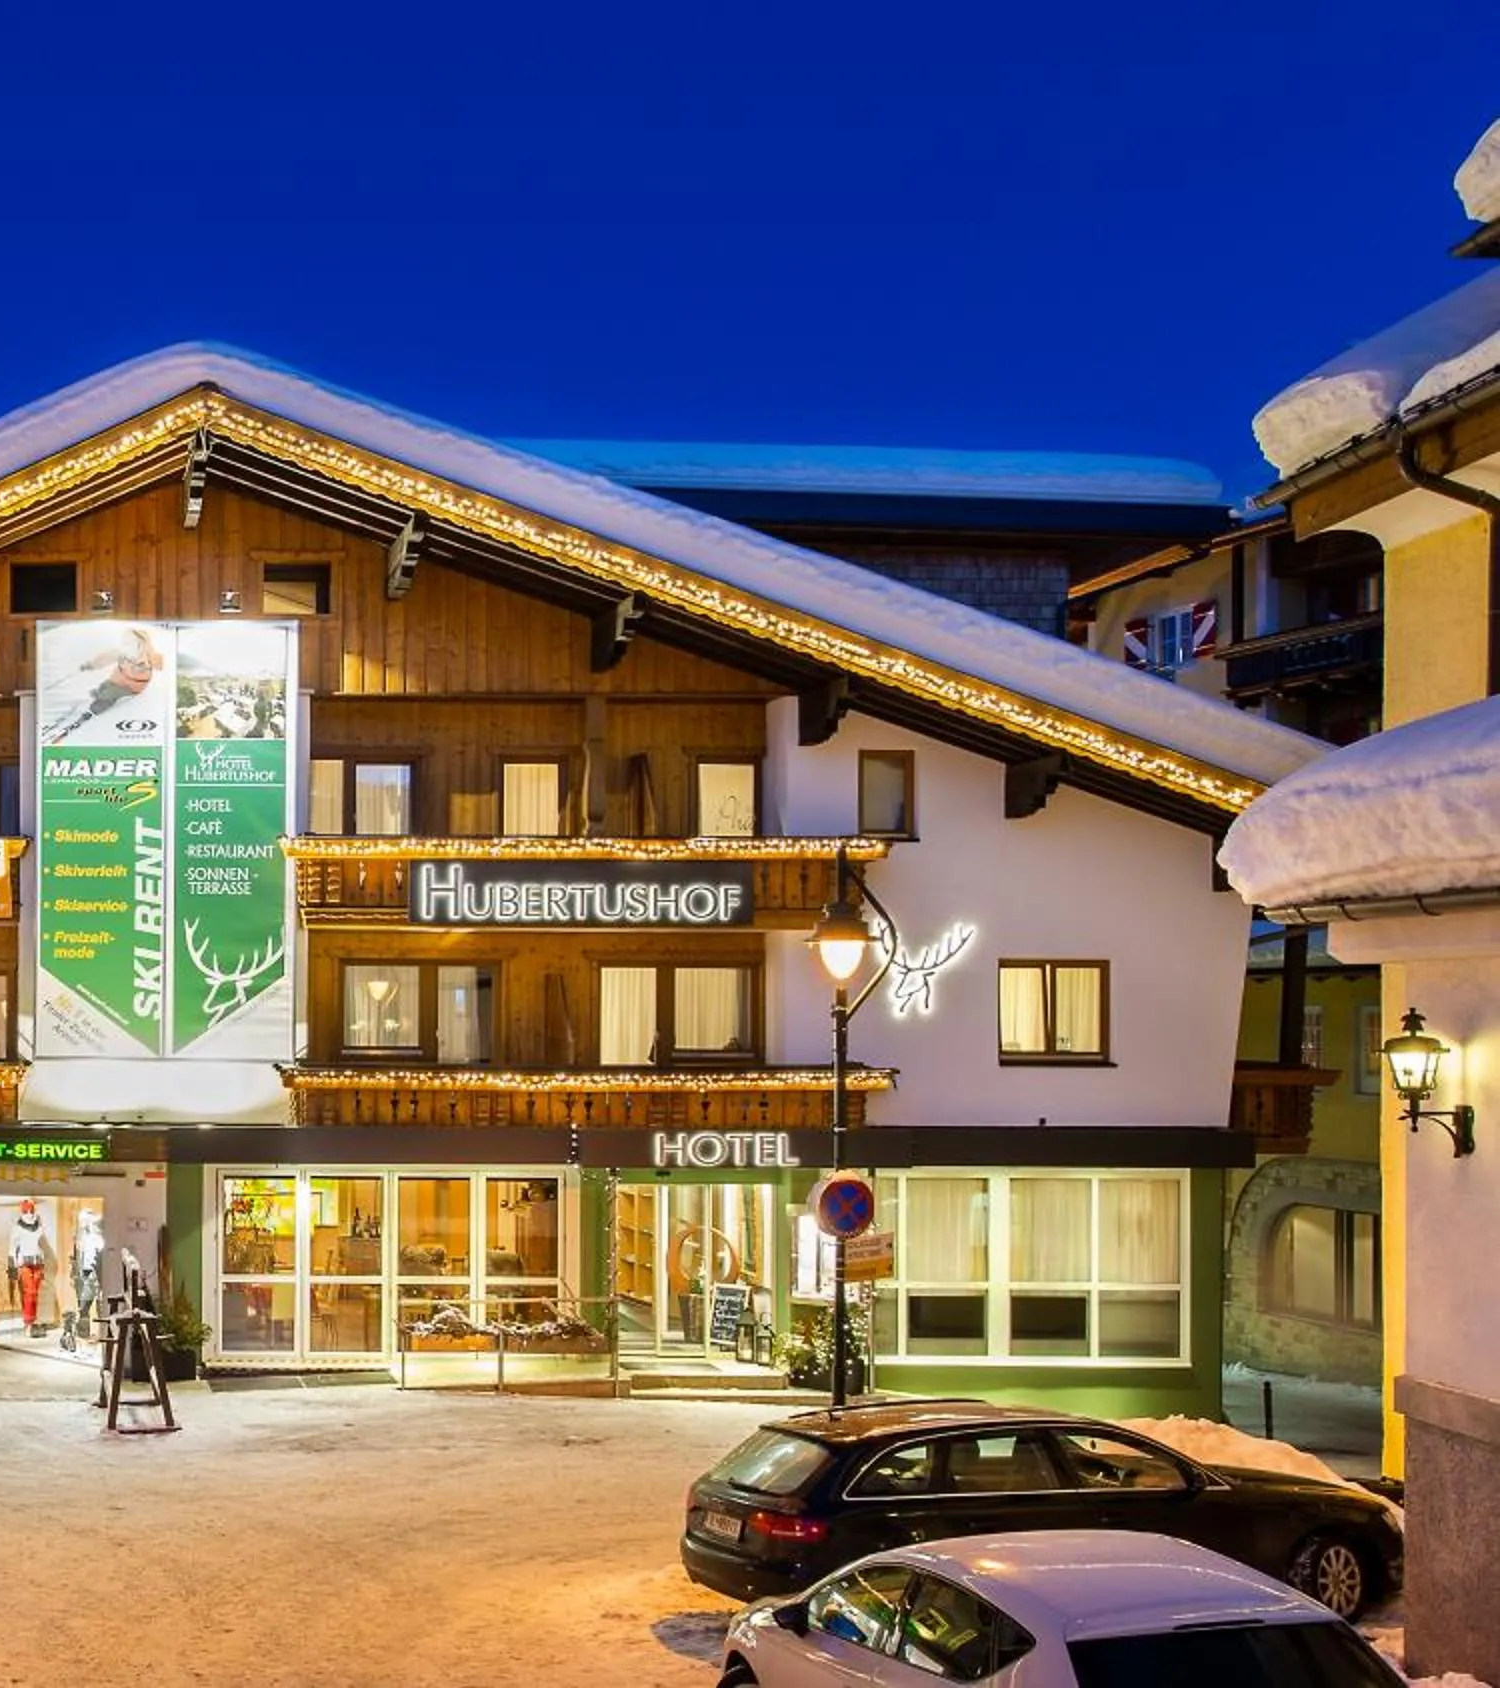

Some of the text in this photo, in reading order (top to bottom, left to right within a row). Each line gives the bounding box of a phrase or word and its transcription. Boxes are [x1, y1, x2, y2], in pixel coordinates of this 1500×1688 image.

[43, 759, 157, 777] MADER
[187, 882, 252, 895] TERRASSE
[418, 863, 744, 922] HUBERTUSHOF
[53, 945, 95, 959] mode
[134, 946, 162, 1021] SKI
[653, 1132, 801, 1168] HOTEL
